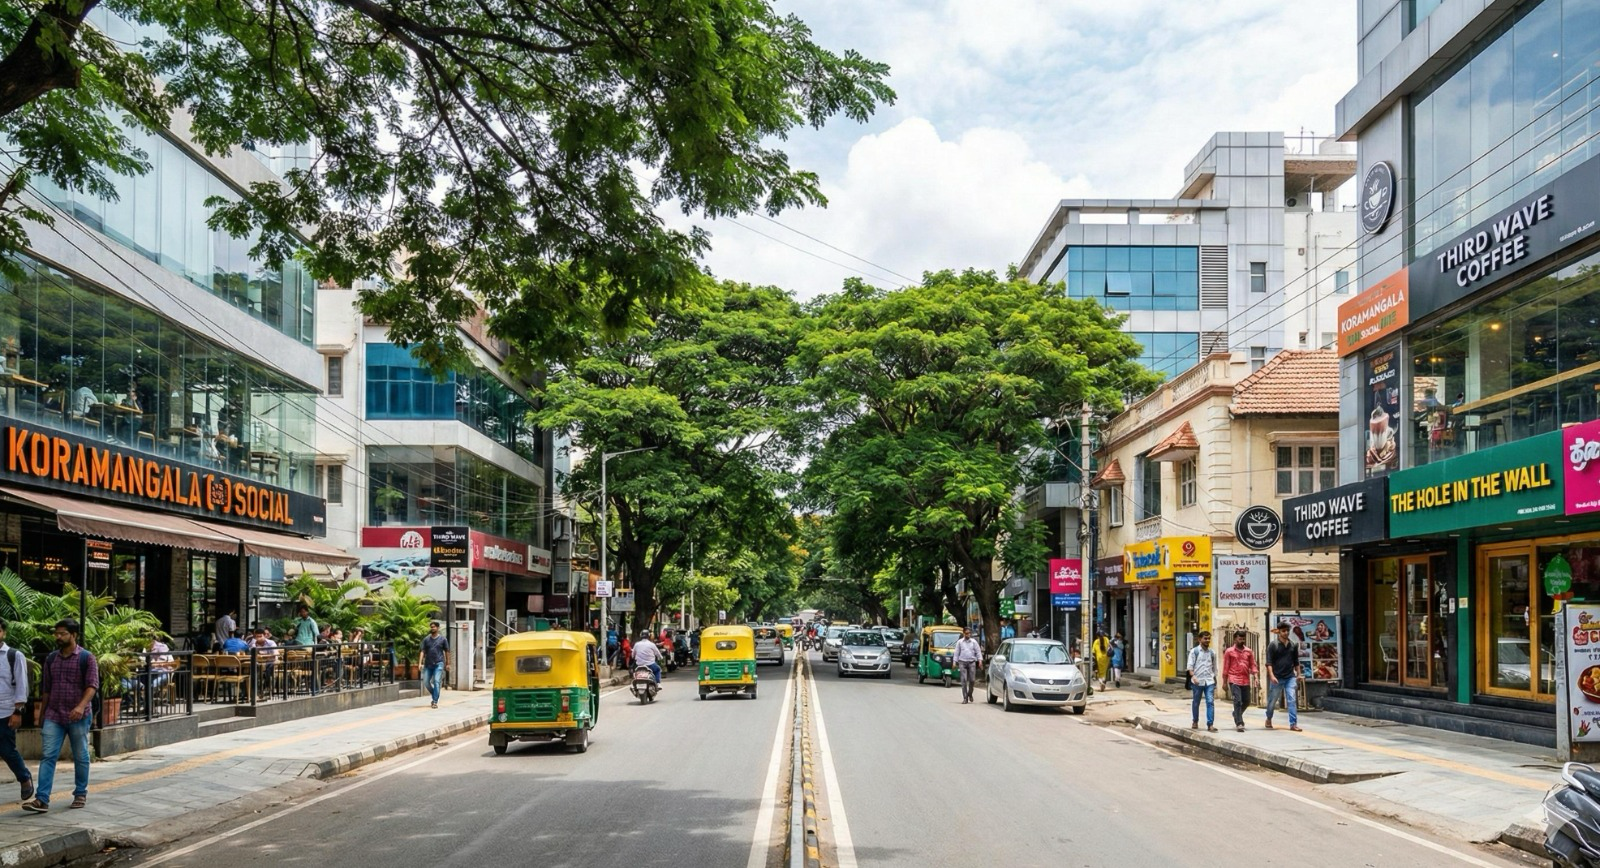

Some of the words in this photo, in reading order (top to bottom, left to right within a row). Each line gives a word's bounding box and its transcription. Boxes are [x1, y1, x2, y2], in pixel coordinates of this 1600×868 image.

[1437, 231, 1488, 273] THIRD
[1493, 194, 1549, 243] WAVE
[1456, 235, 1524, 287] COFFEE
[1341, 289, 1405, 335] KORAMANGALA
[9, 426, 201, 508] KORAMANGALA
[235, 482, 294, 525] SOCIAL
[1391, 491, 1414, 514] THE
[1416, 483, 1450, 510] HOLE
[1453, 479, 1468, 502] IN
[1471, 472, 1500, 498] THE
[1503, 462, 1551, 492] WALL
[1294, 501, 1326, 523] THIRD
[1328, 492, 1363, 516] WAVE
[1306, 517, 1349, 540] COFFEE
